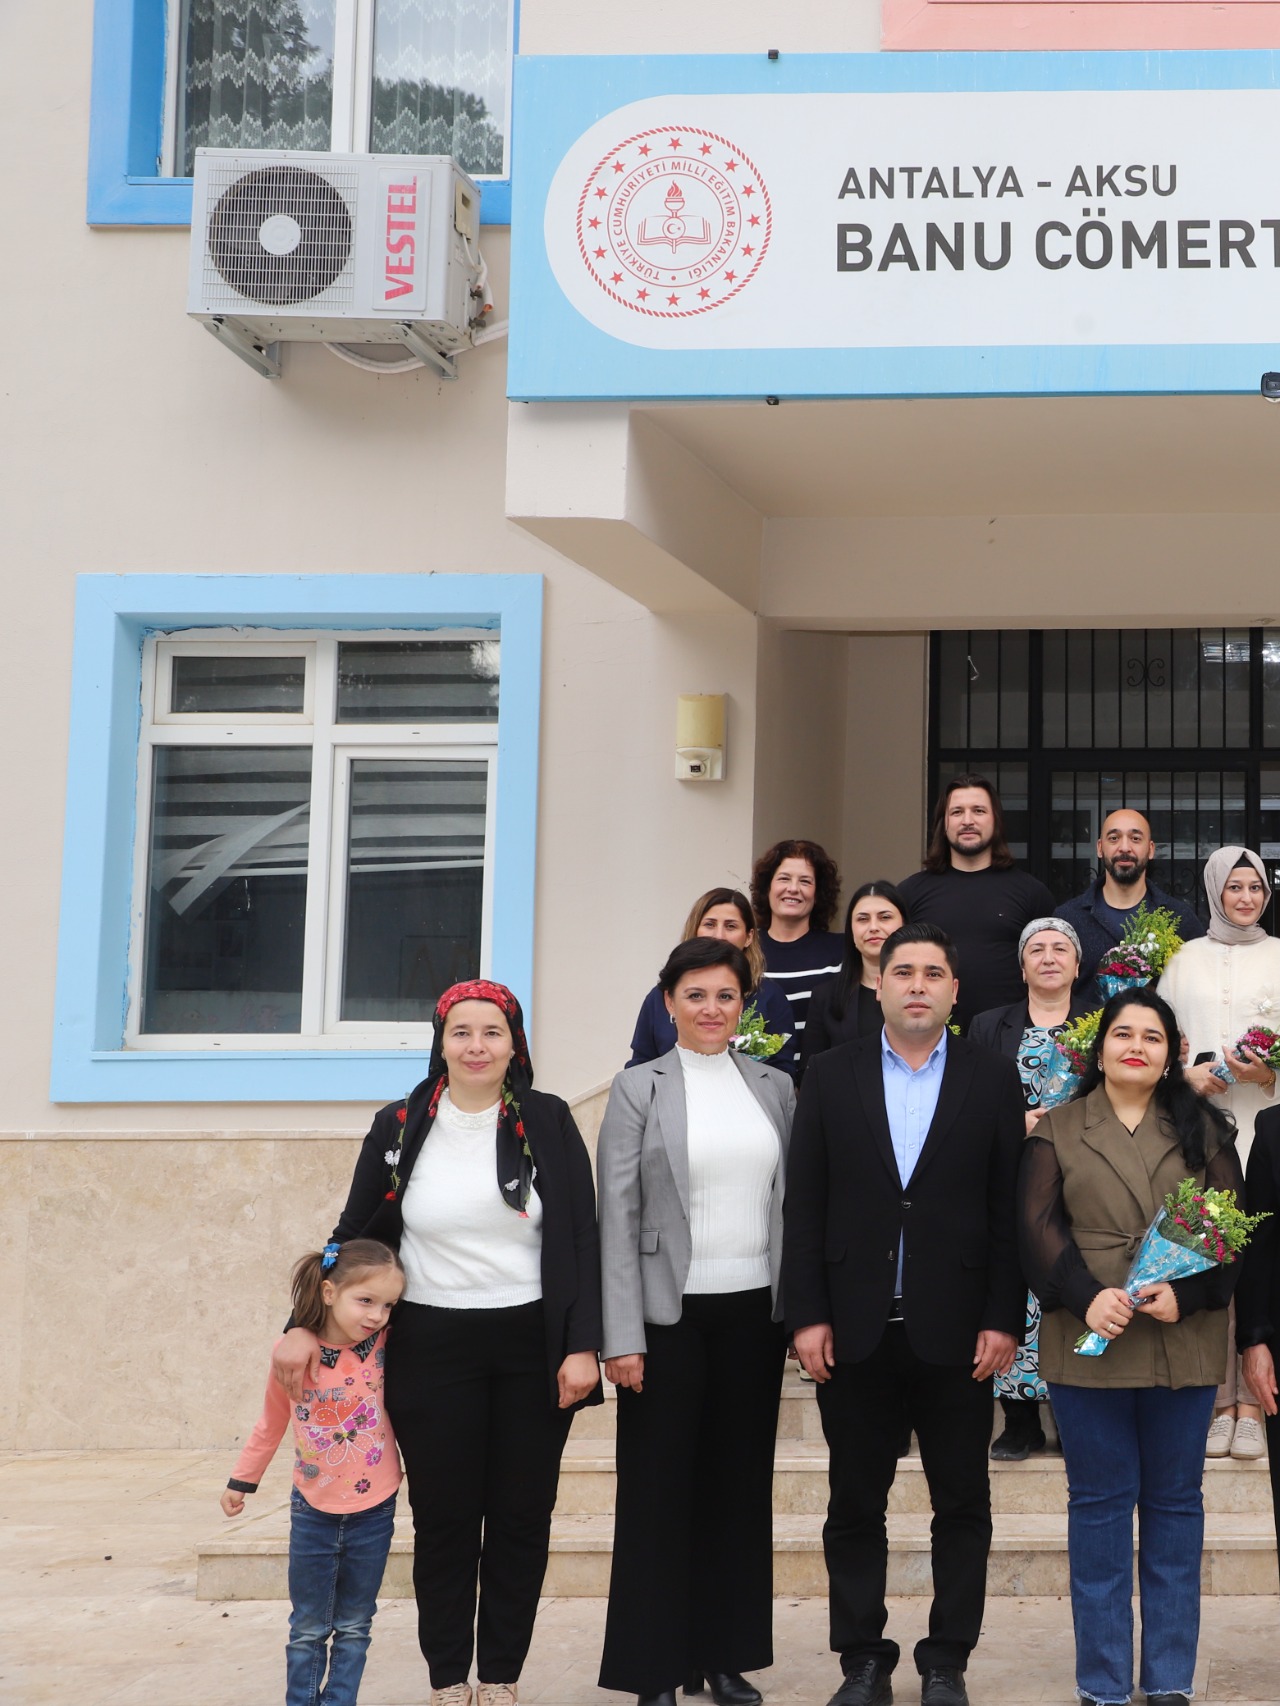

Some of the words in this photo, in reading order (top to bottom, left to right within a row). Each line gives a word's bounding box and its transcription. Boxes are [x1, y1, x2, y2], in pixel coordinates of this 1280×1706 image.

[613, 161, 666, 235] CUMHURİYETİ
[708, 174, 736, 216] EĞİTİM
[837, 166, 1024, 200] ANTALYA
[1064, 164, 1177, 198] AKSU
[384, 175, 418, 301] VESTEL
[616, 239, 660, 281] TÜRKİYE
[688, 220, 736, 280] BAKANLIĞI
[836, 220, 1013, 272] BANU
[302, 1387, 347, 1404] OVE
